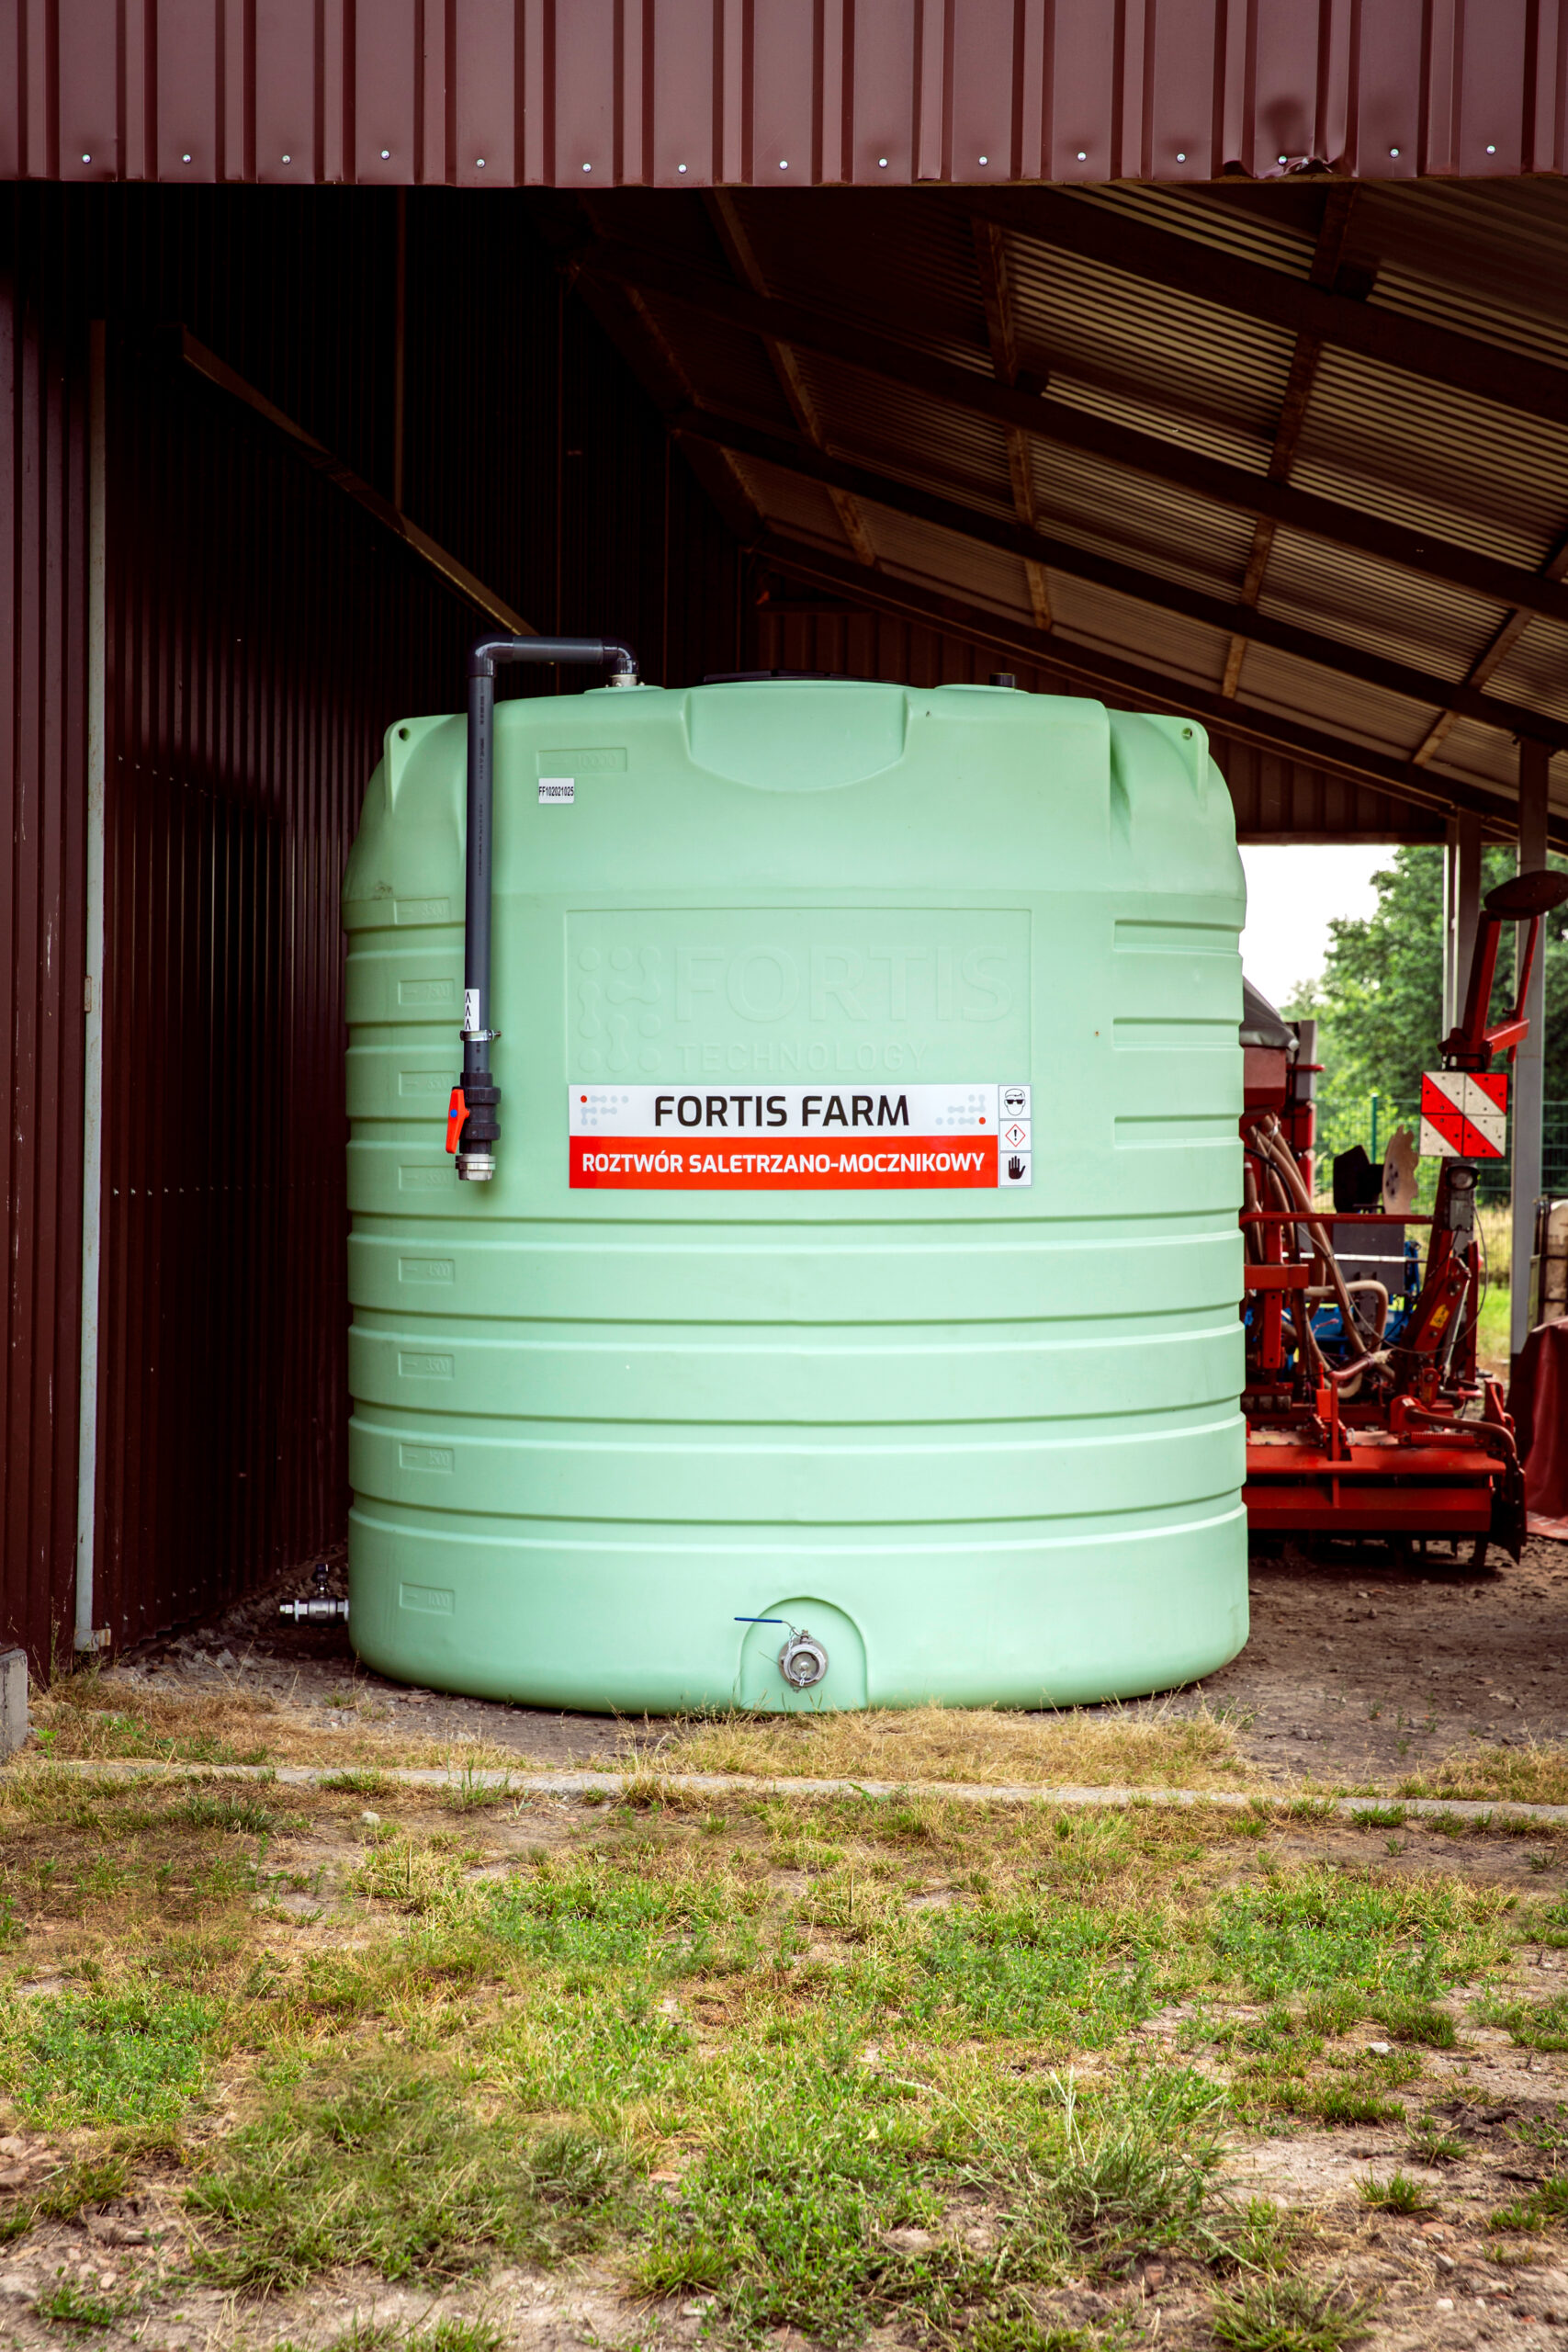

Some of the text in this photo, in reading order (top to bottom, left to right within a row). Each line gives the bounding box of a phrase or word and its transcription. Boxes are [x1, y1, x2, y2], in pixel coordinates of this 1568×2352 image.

[674, 944, 1015, 1023] FORTIS
[676, 1041, 930, 1073] TECHNOLOGY
[656, 1095, 908, 1126] FORTIS FARM
[583, 1150, 985, 1172] ROZTWÓR SALETRZANO-MOCZNIKOWY
